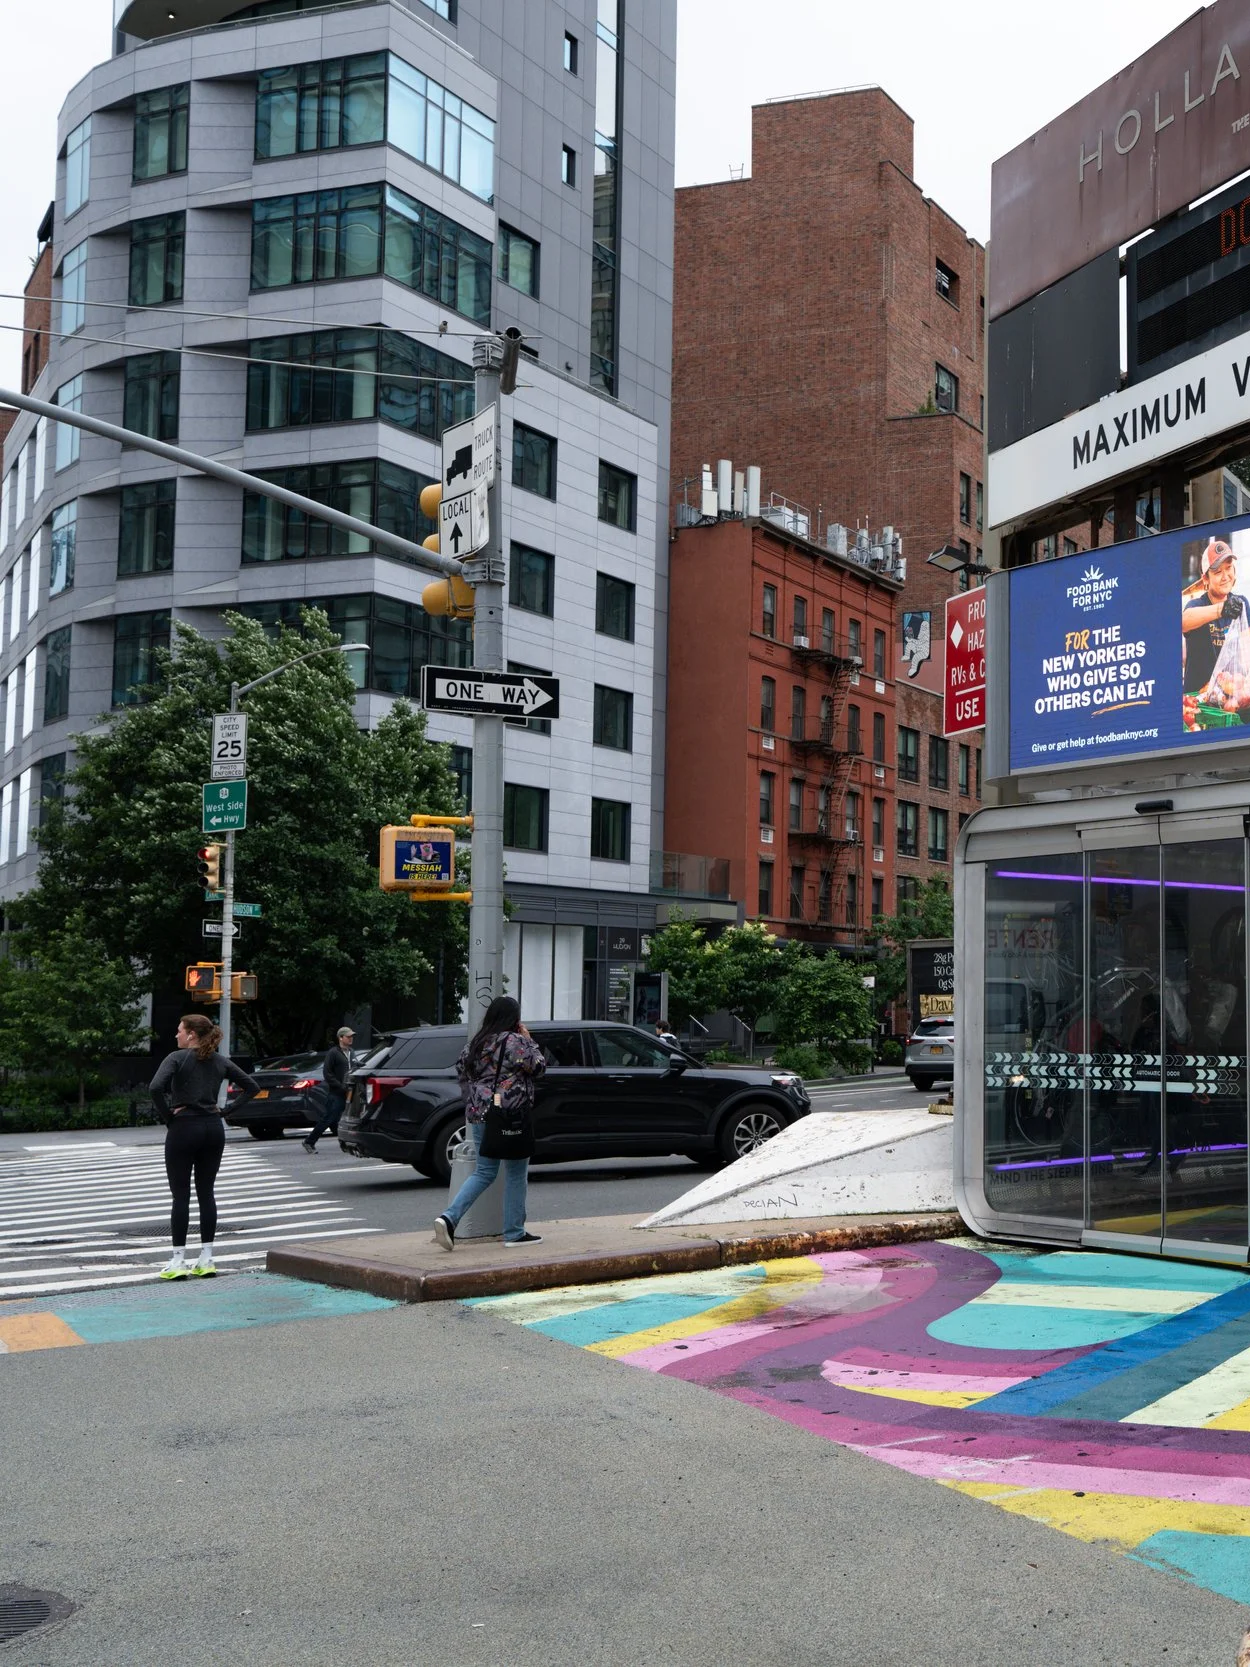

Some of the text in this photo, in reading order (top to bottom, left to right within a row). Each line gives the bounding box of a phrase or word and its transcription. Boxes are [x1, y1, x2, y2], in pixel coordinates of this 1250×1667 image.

[1231, 108, 1249, 134] THE
[1072, 377, 1206, 470] MAXIMUM
[474, 425, 494, 451] TRUCK
[473, 453, 493, 481] ROUTE
[443, 497, 469, 521] LOCAL
[1066, 577, 1119, 598] FOOD BANK
[1072, 590, 1112, 608] FOR NYC
[968, 598, 985, 622] PRO
[967, 629, 985, 652] HAZ
[1065, 625, 1121, 653] FOR THE
[1042, 641, 1146, 675] NEW YORKERS
[951, 664, 967, 686] RVs
[969, 662, 976, 681] &
[1047, 662, 1141, 693] WHO GIVE SO
[446, 681, 540, 705] ONE WAY
[1034, 680, 1156, 714] OTHERS CAN EAT
[955, 697, 980, 721] USE
[217, 740, 242, 758] 25
[1031, 728, 1159, 753] Give or get help at foodbanknyc.org
[206, 801, 244, 812] West Side
[223, 815, 240, 824] Hwy
[402, 864, 442, 872] MESSIAH
[934, 953, 946, 965] 28g
[934, 966, 945, 976] 150
[938, 980, 948, 990] 0g
[990, 1174, 1021, 1185] MIND
[1024, 1170, 1045, 1182] THE
[1047, 1166, 1071, 1179] STEP
